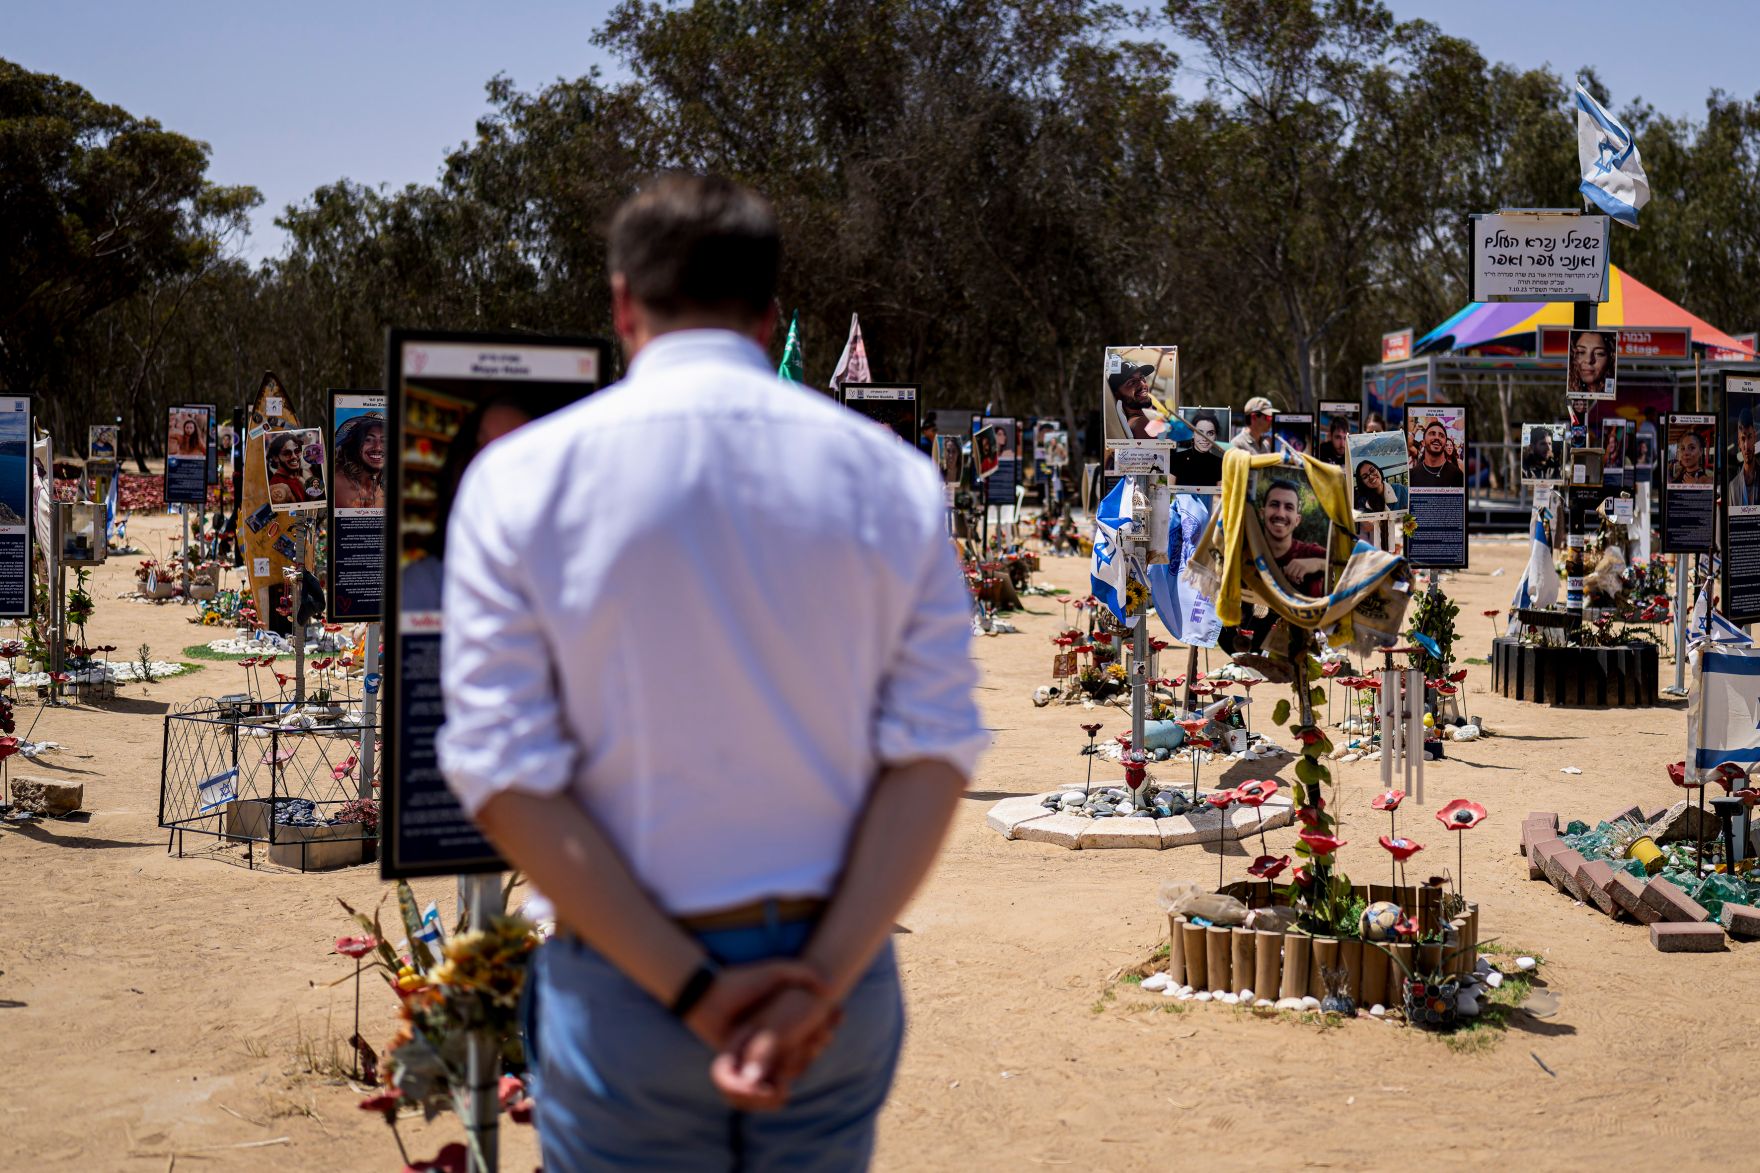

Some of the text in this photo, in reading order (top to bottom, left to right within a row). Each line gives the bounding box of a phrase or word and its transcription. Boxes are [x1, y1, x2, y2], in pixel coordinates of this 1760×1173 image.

[1485, 230, 1600, 252] בשבילי נברא העולם
[1487, 254, 1596, 271] ואנוכי עפר ואפר
[1622, 333, 1651, 343] הבמה
[1625, 345, 1660, 355] Stage
